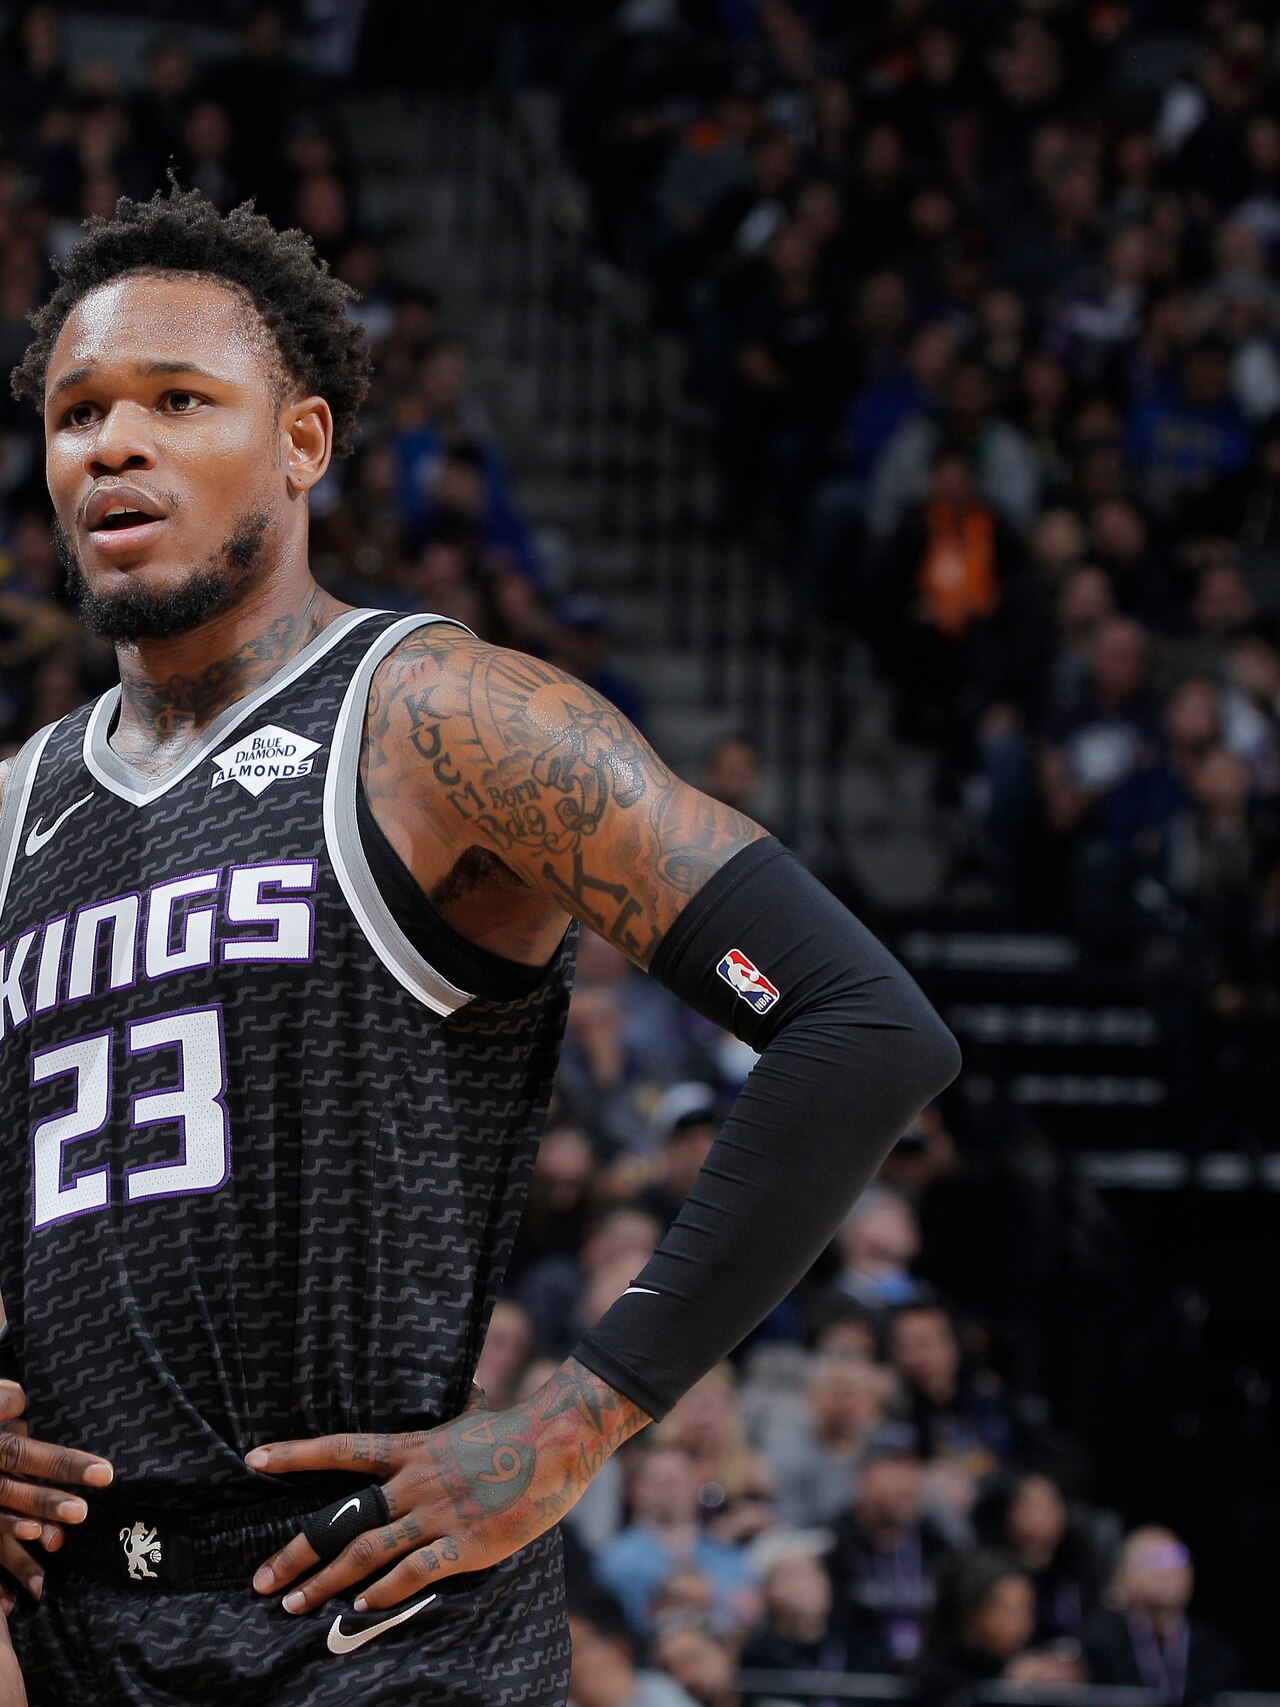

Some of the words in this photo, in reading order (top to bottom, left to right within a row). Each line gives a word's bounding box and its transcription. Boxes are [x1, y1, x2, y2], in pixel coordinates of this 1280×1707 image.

[235, 745, 297, 764] DIAMOND
[215, 763, 310, 784] ALMONDS
[754, 993, 773, 1011] NBA
[29, 1003, 232, 1231] 23
